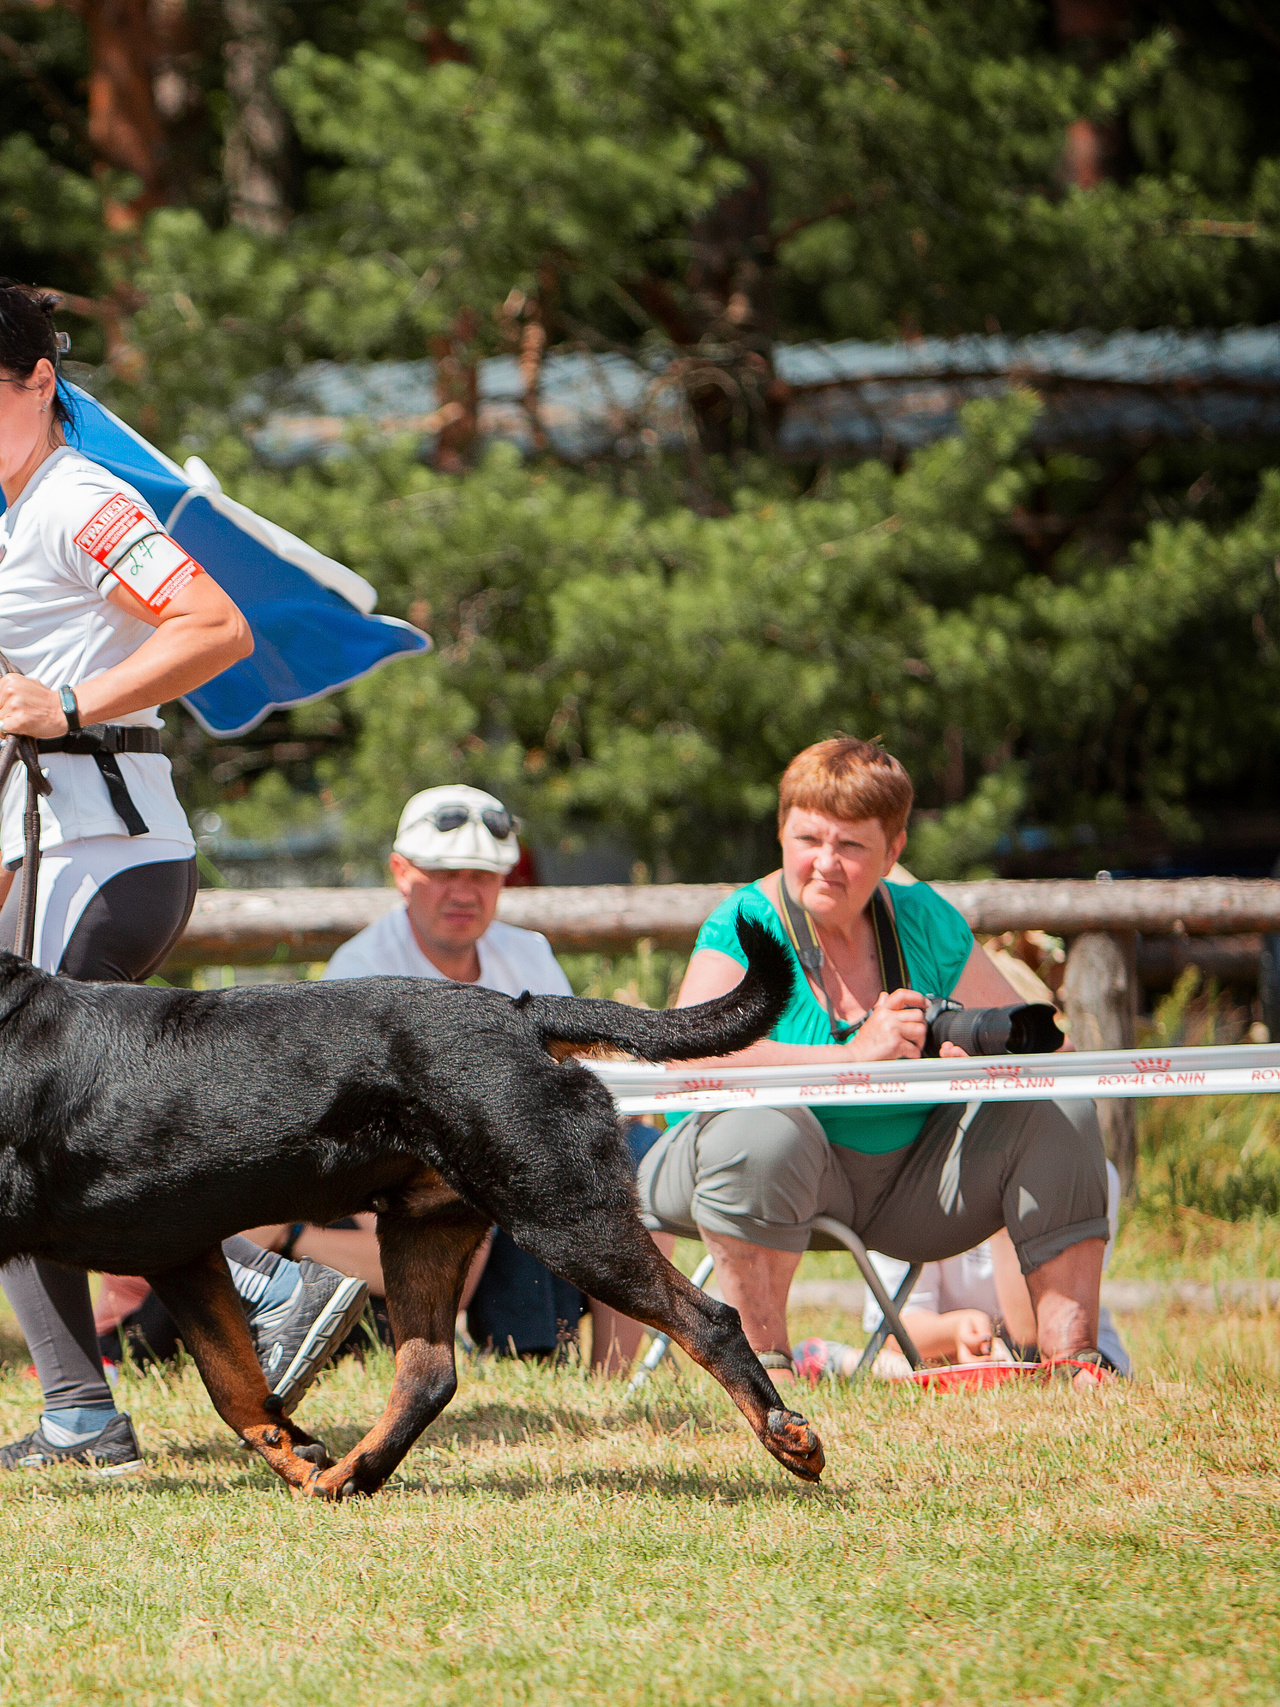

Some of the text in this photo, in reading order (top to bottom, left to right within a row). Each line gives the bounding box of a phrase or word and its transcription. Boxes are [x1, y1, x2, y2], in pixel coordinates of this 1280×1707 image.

[79, 498, 130, 547] ТРАПЕЗА
[1098, 1071, 1206, 1086] ROYAL CANIN
[1252, 1069, 1280, 1081] ROY
[799, 1081, 907, 1097] ROYAL CANIN
[950, 1076, 1055, 1091] ROYAL CANIN
